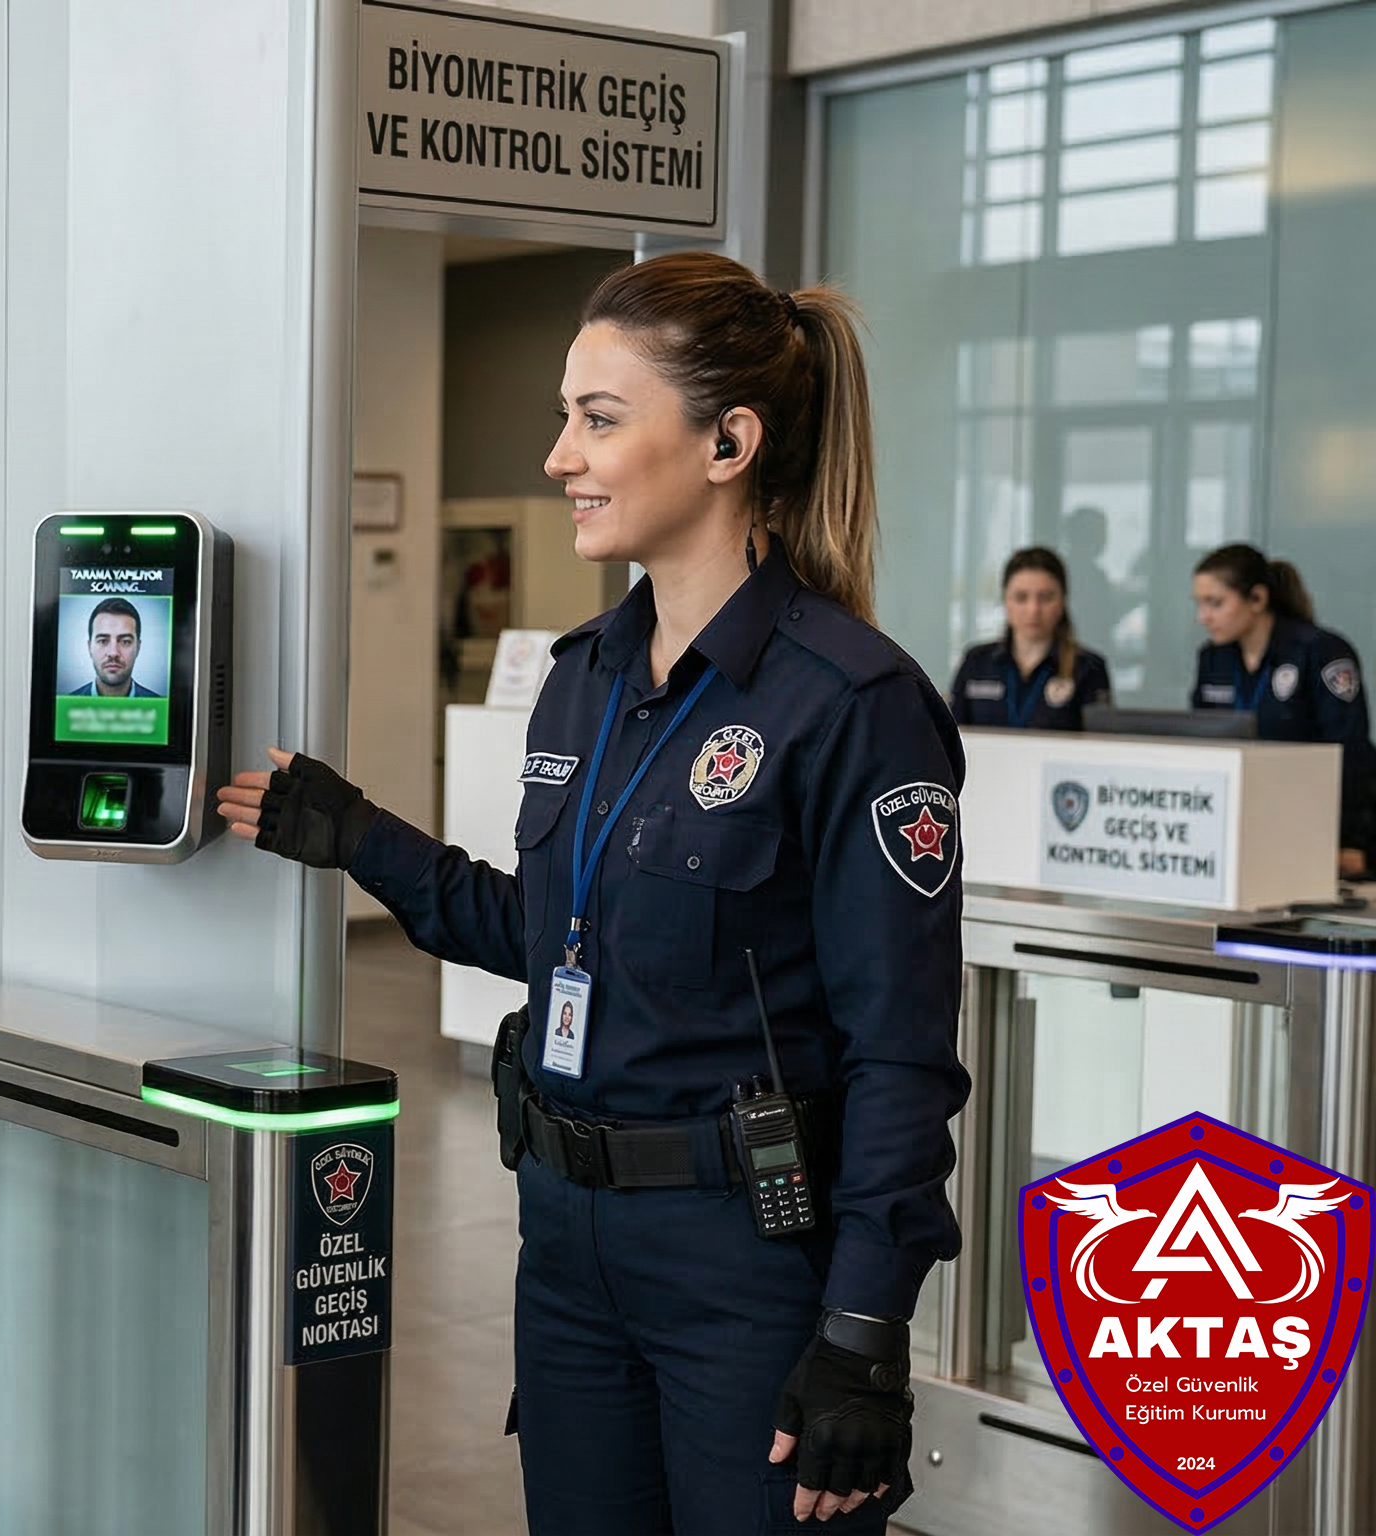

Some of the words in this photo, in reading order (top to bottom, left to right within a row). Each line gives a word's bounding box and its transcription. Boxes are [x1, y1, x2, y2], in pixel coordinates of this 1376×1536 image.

[388, 39, 588, 113] BİYOMETRİK
[598, 72, 686, 136] GEÇİŞ
[366, 111, 409, 159] VE
[420, 117, 571, 176] KONTROL
[581, 129, 703, 190] SİSTEMİ
[1097, 783, 1214, 813] BİYOMETRİK
[1104, 813, 1158, 844] GEÇİŞ
[1164, 821, 1189, 844] VE
[1046, 843, 1134, 871] KONTROL
[1139, 850, 1216, 877] SİSTEMİ
[320, 1232, 365, 1258] ÖZEL
[296, 1254, 386, 1290] GÜVENLİK
[315, 1285, 368, 1317] GEÇİŞ
[302, 1314, 378, 1347] NOKTASI
